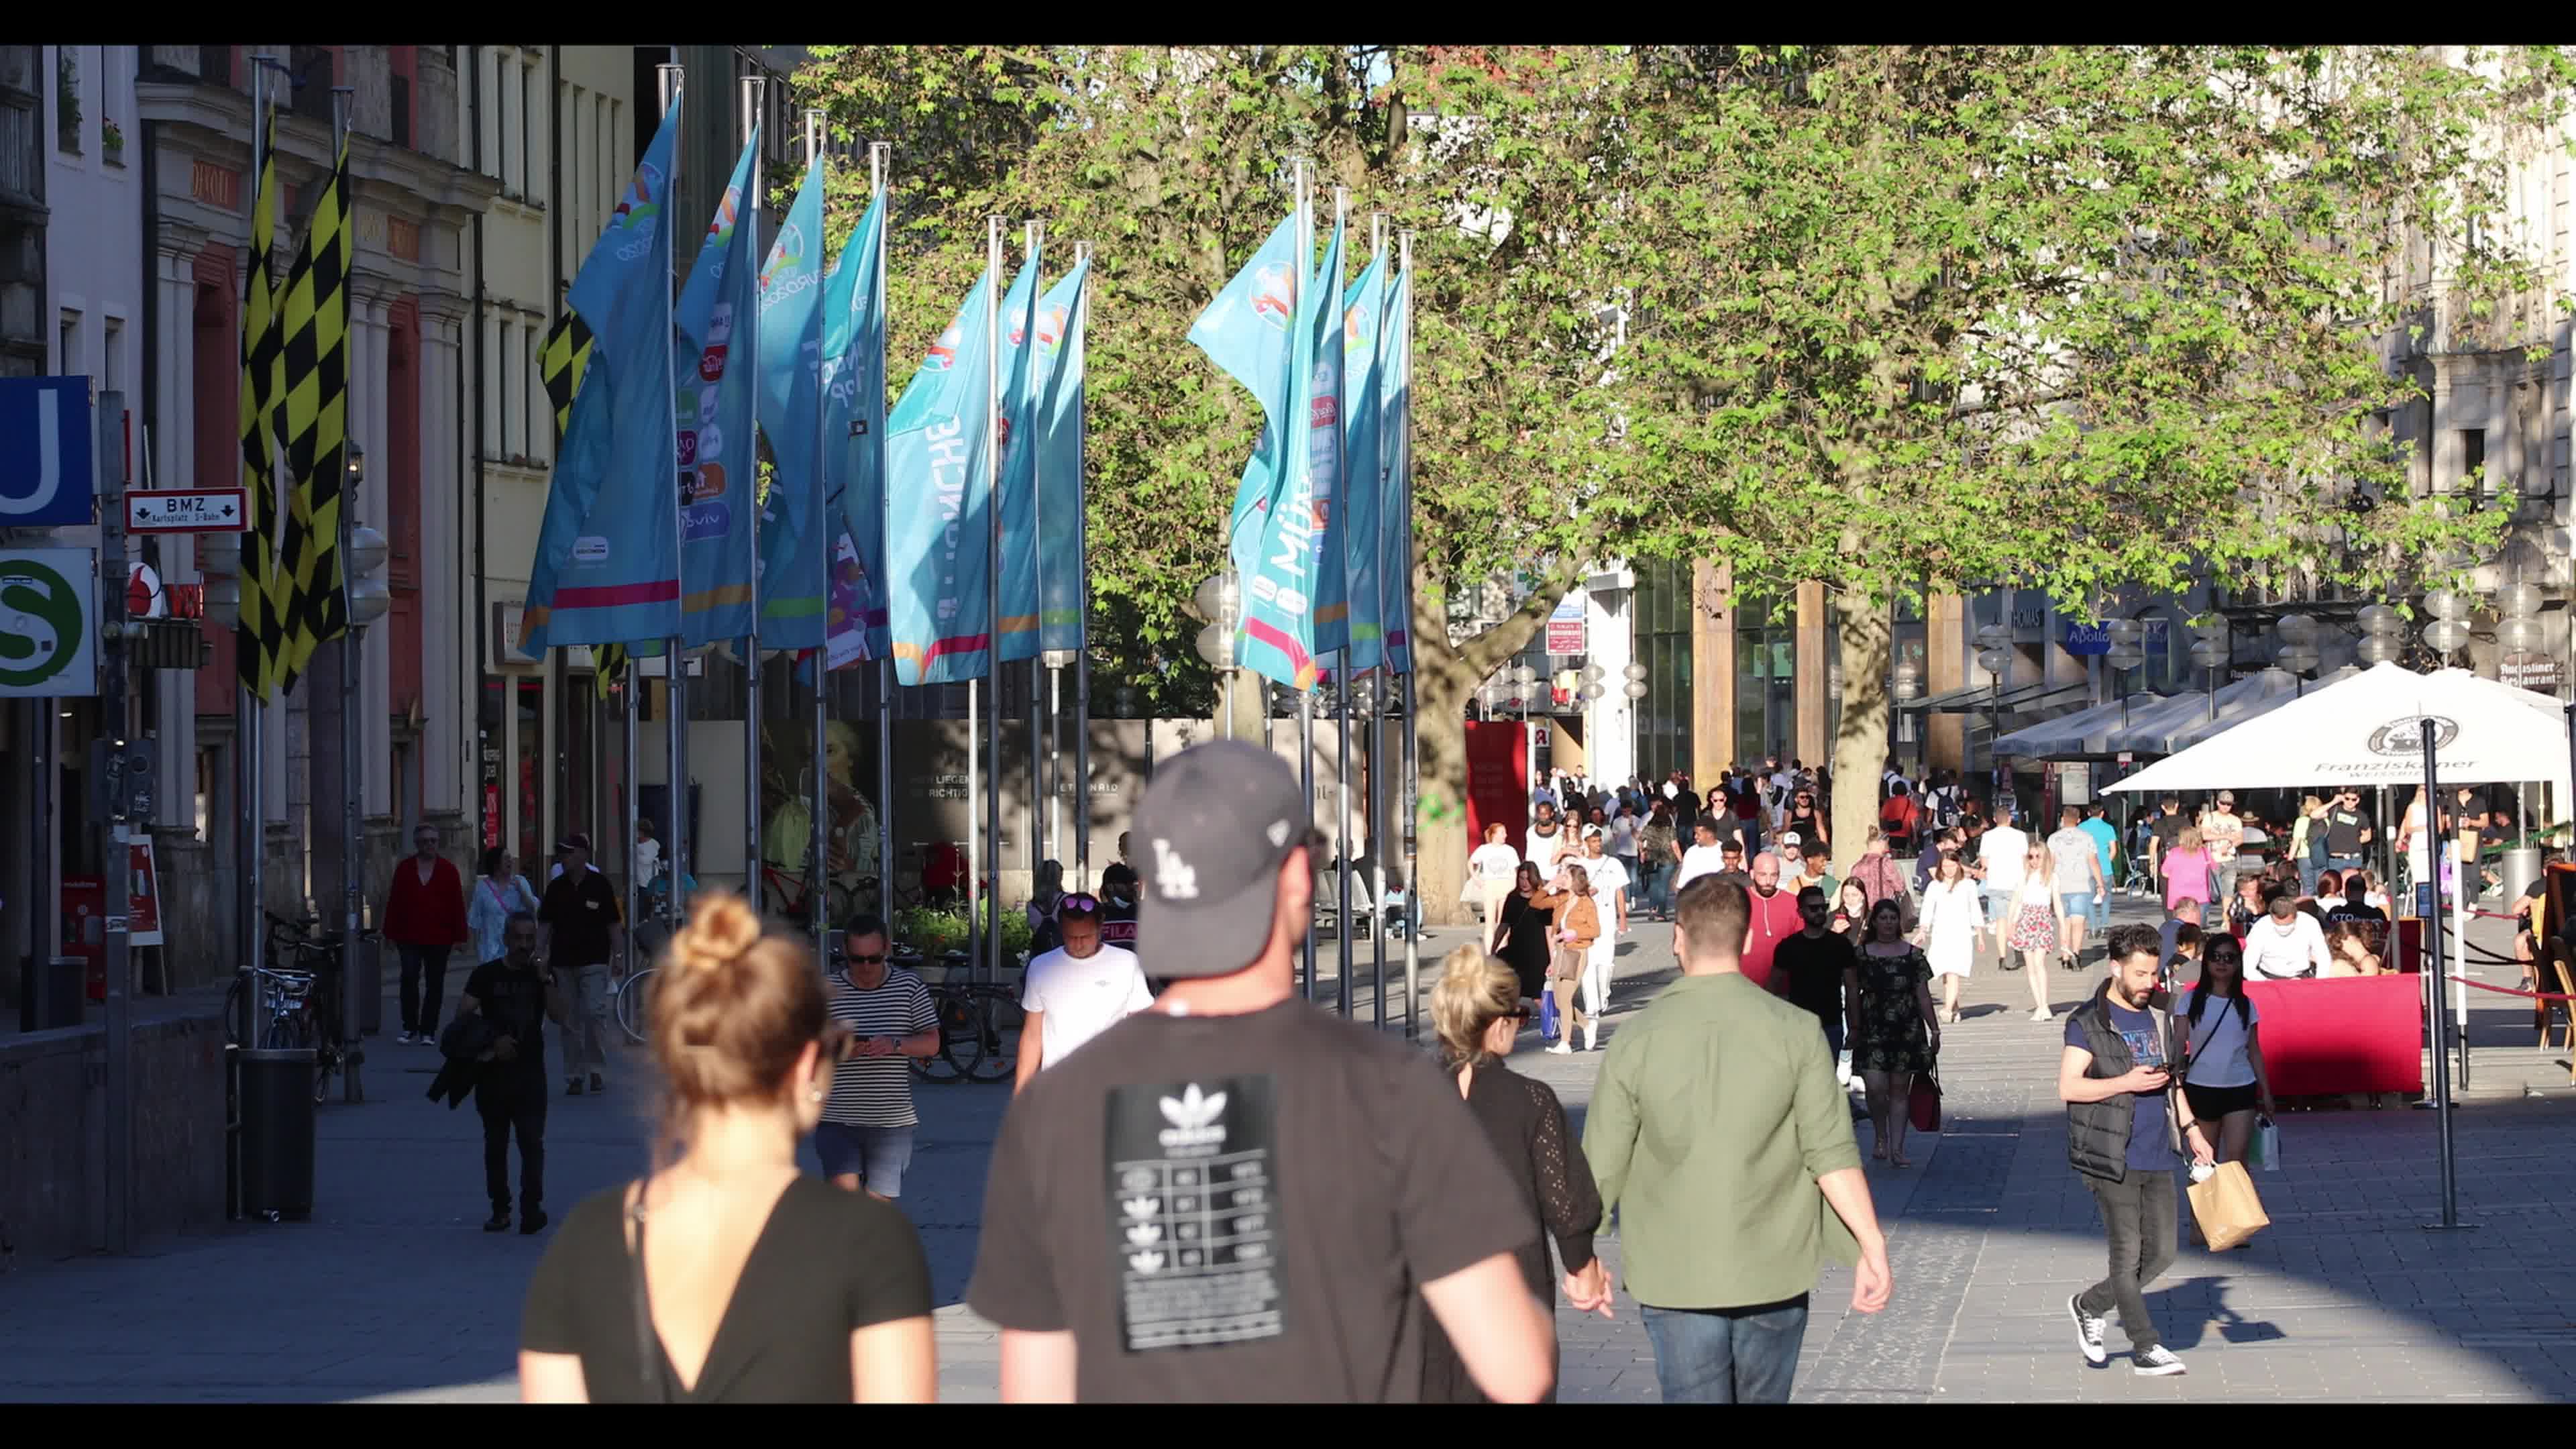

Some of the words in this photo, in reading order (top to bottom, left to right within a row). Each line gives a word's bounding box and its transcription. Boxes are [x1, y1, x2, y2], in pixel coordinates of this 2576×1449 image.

[0, 388, 60, 515] U
[166, 497, 205, 513] BMZ
[2069, 629, 2110, 645] Apollo
[2314, 760, 2477, 772] Franziskner
[1100, 924, 1136, 938] FILA
